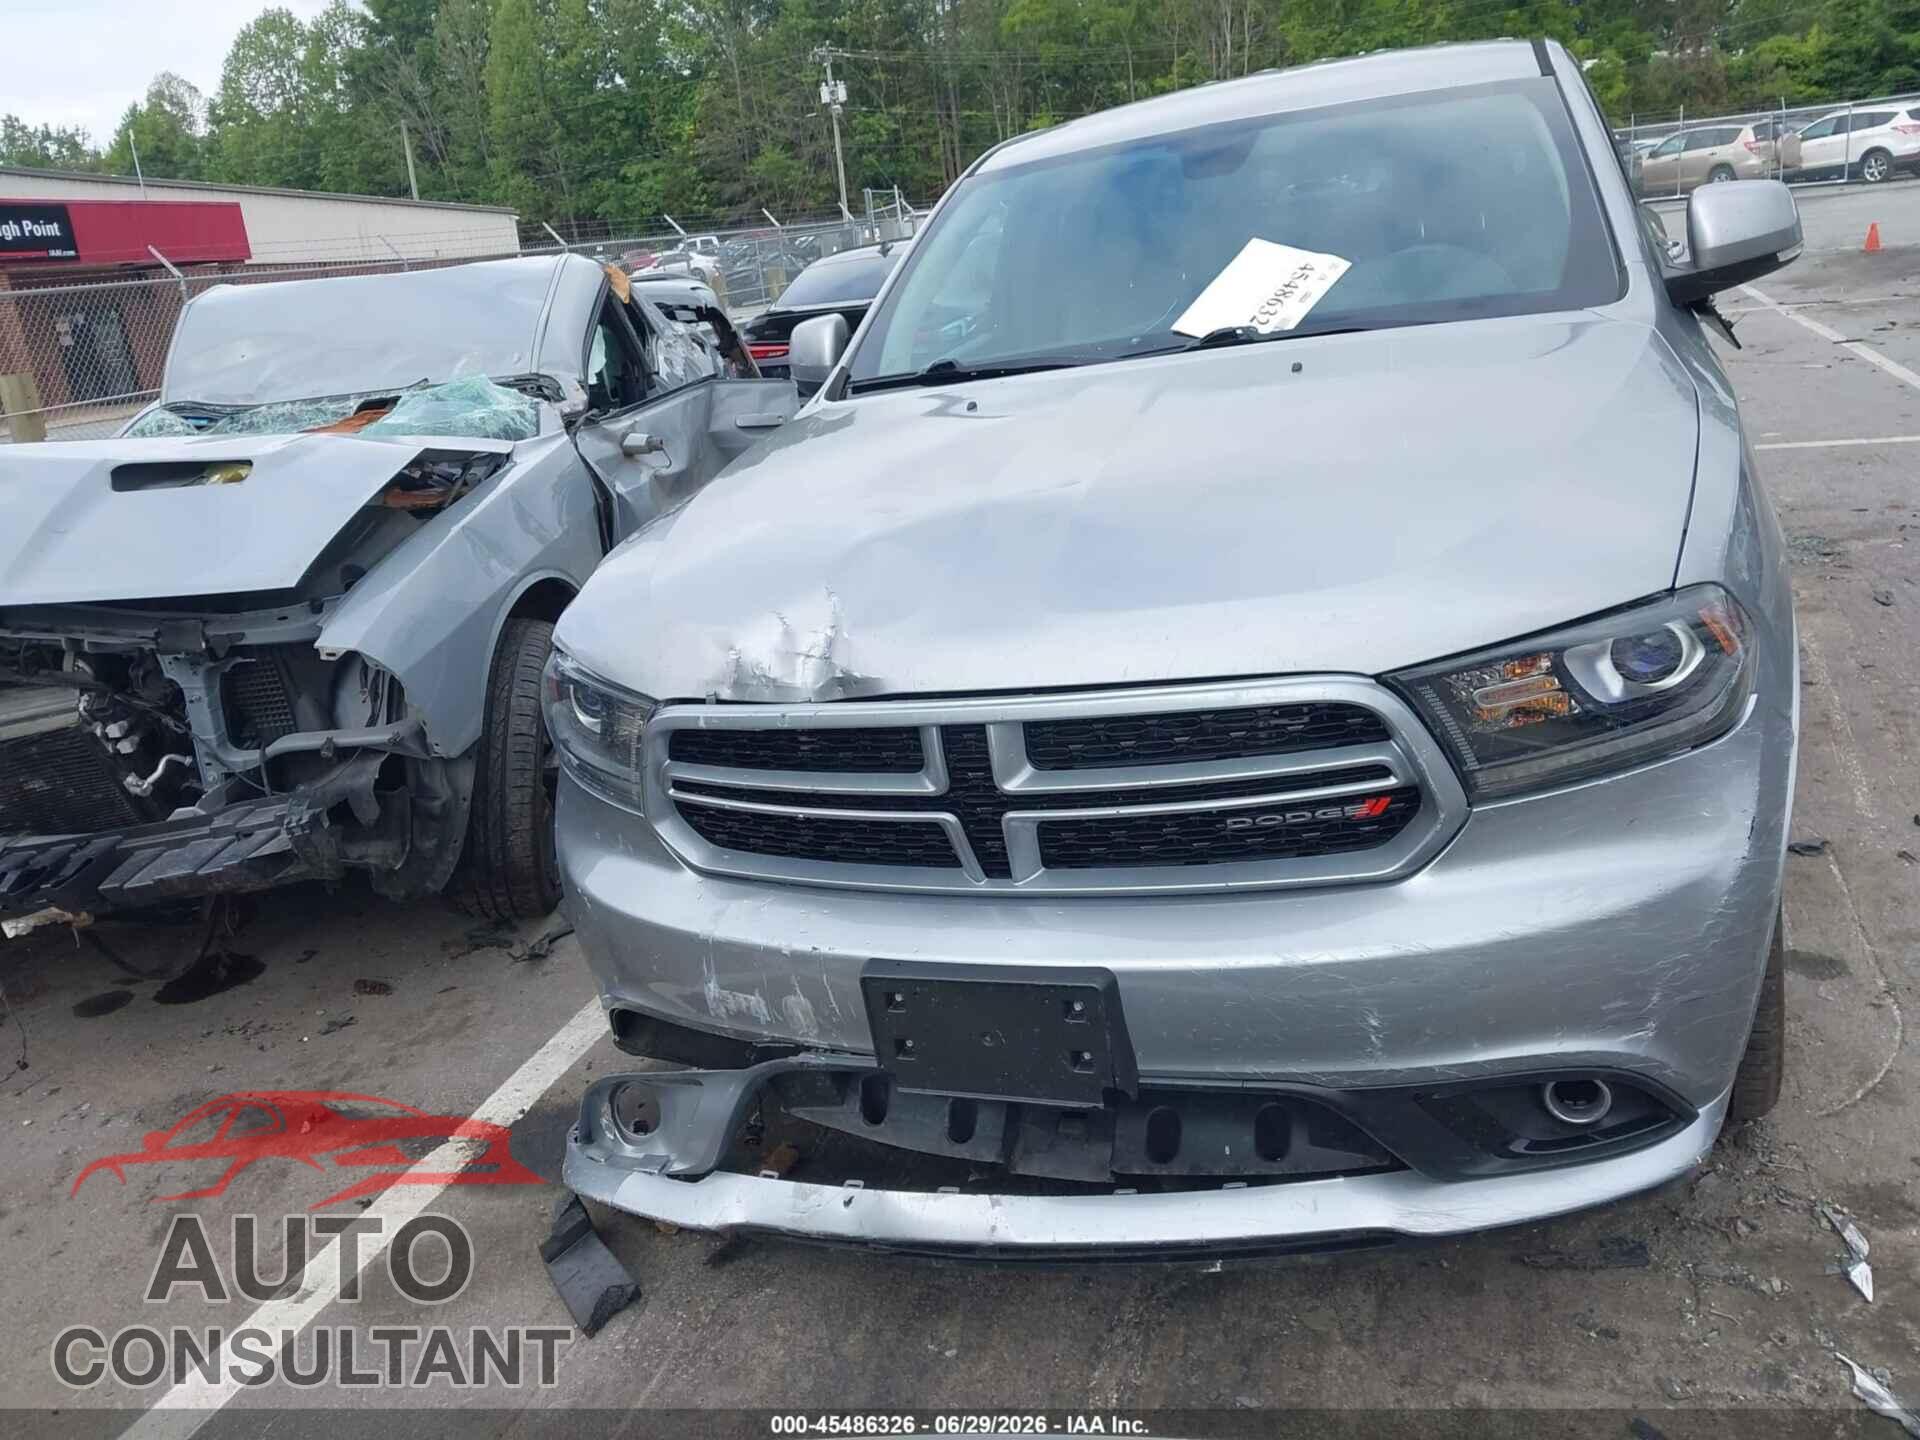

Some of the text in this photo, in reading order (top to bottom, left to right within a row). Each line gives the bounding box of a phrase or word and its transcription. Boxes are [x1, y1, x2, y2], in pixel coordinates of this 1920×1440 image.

[0, 219, 61, 241] gh Point
[1226, 803, 1370, 829] DODGE
